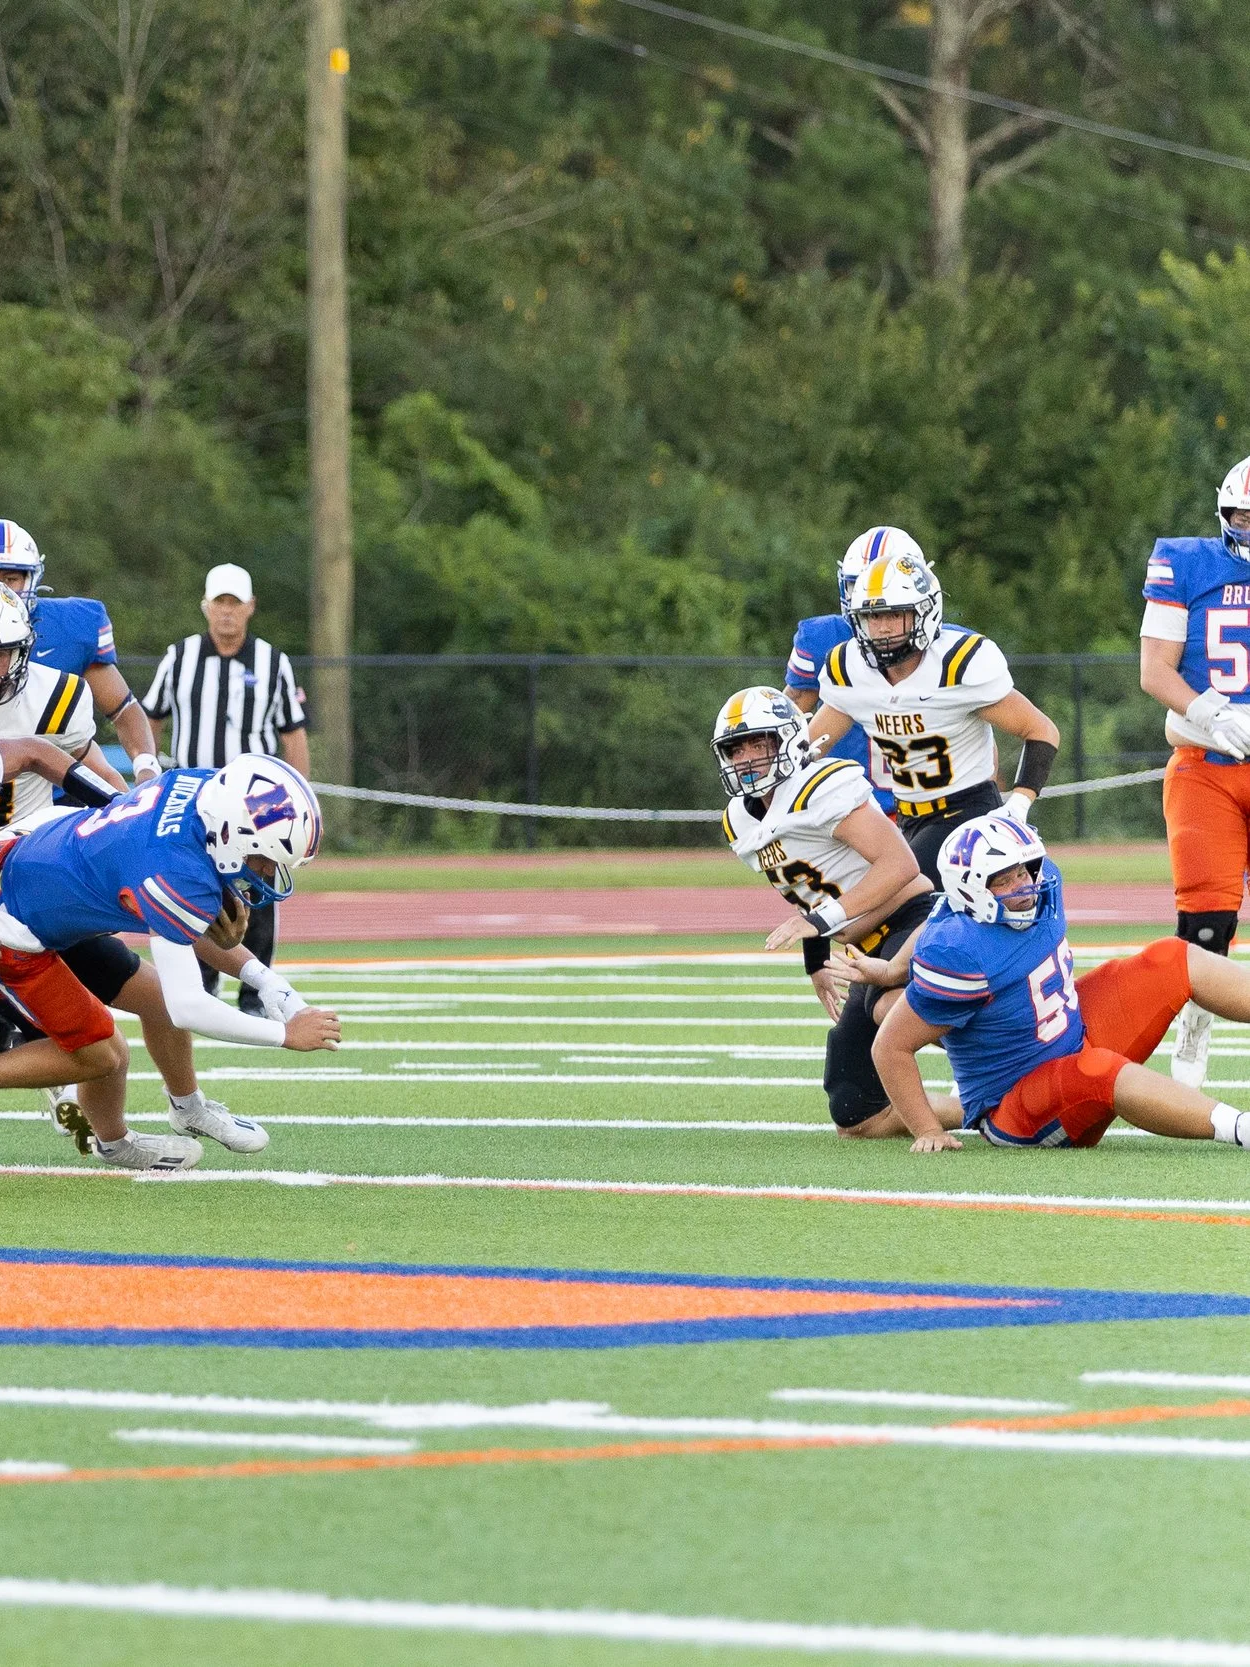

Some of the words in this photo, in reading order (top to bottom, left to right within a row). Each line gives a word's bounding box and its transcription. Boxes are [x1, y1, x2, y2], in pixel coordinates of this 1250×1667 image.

[874, 713, 925, 736] NEERS
[871, 734, 954, 791] 23
[75, 784, 165, 837] 3
[244, 784, 298, 831] N
[949, 828, 983, 868] N
